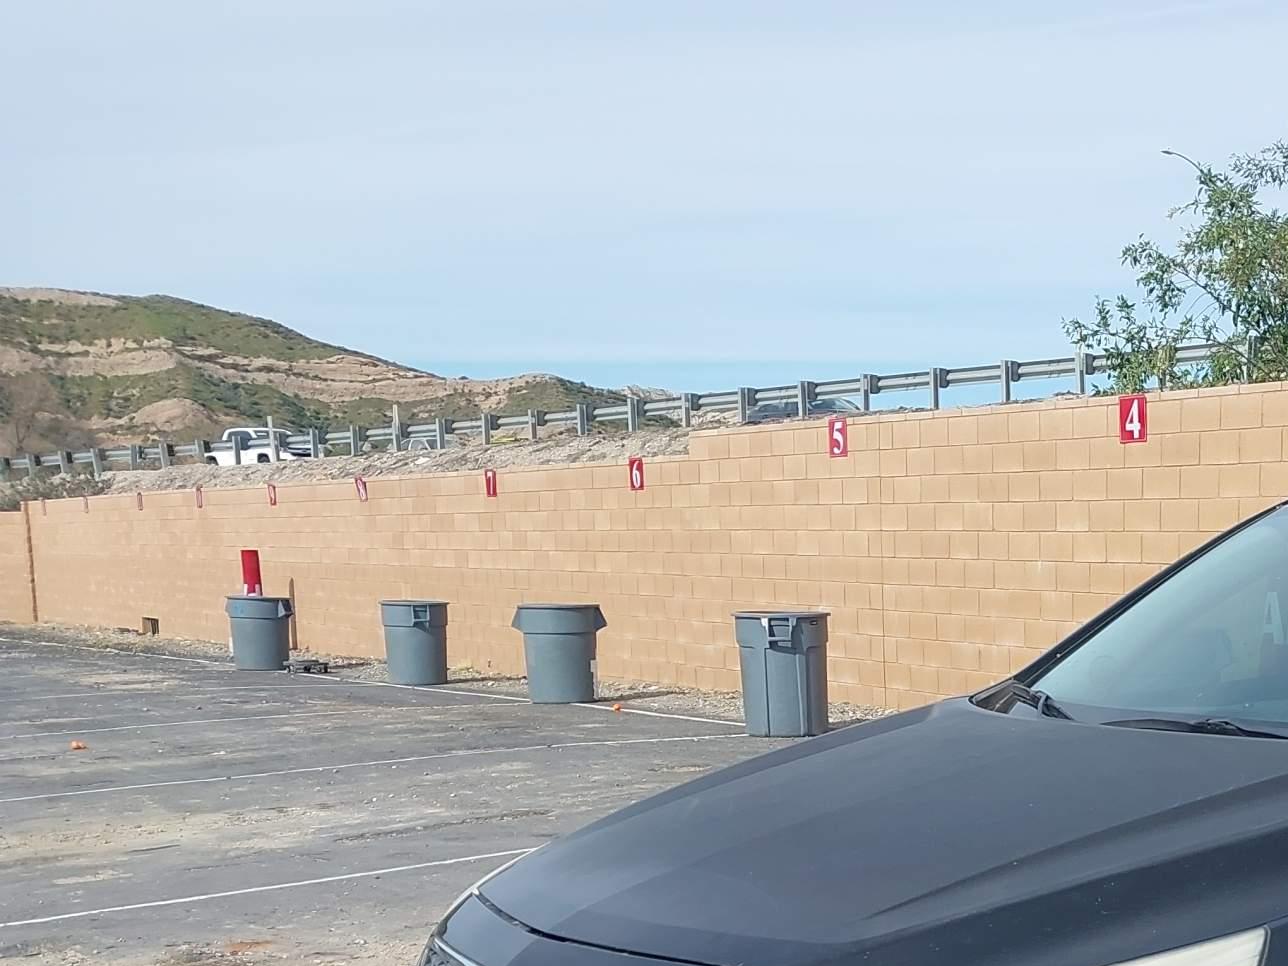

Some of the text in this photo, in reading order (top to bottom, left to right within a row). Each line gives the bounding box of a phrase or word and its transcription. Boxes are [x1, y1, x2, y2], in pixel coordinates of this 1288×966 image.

[1125, 399, 1141, 439] 4
[832, 421, 844, 454] 5
[632, 460, 641, 489] 6
